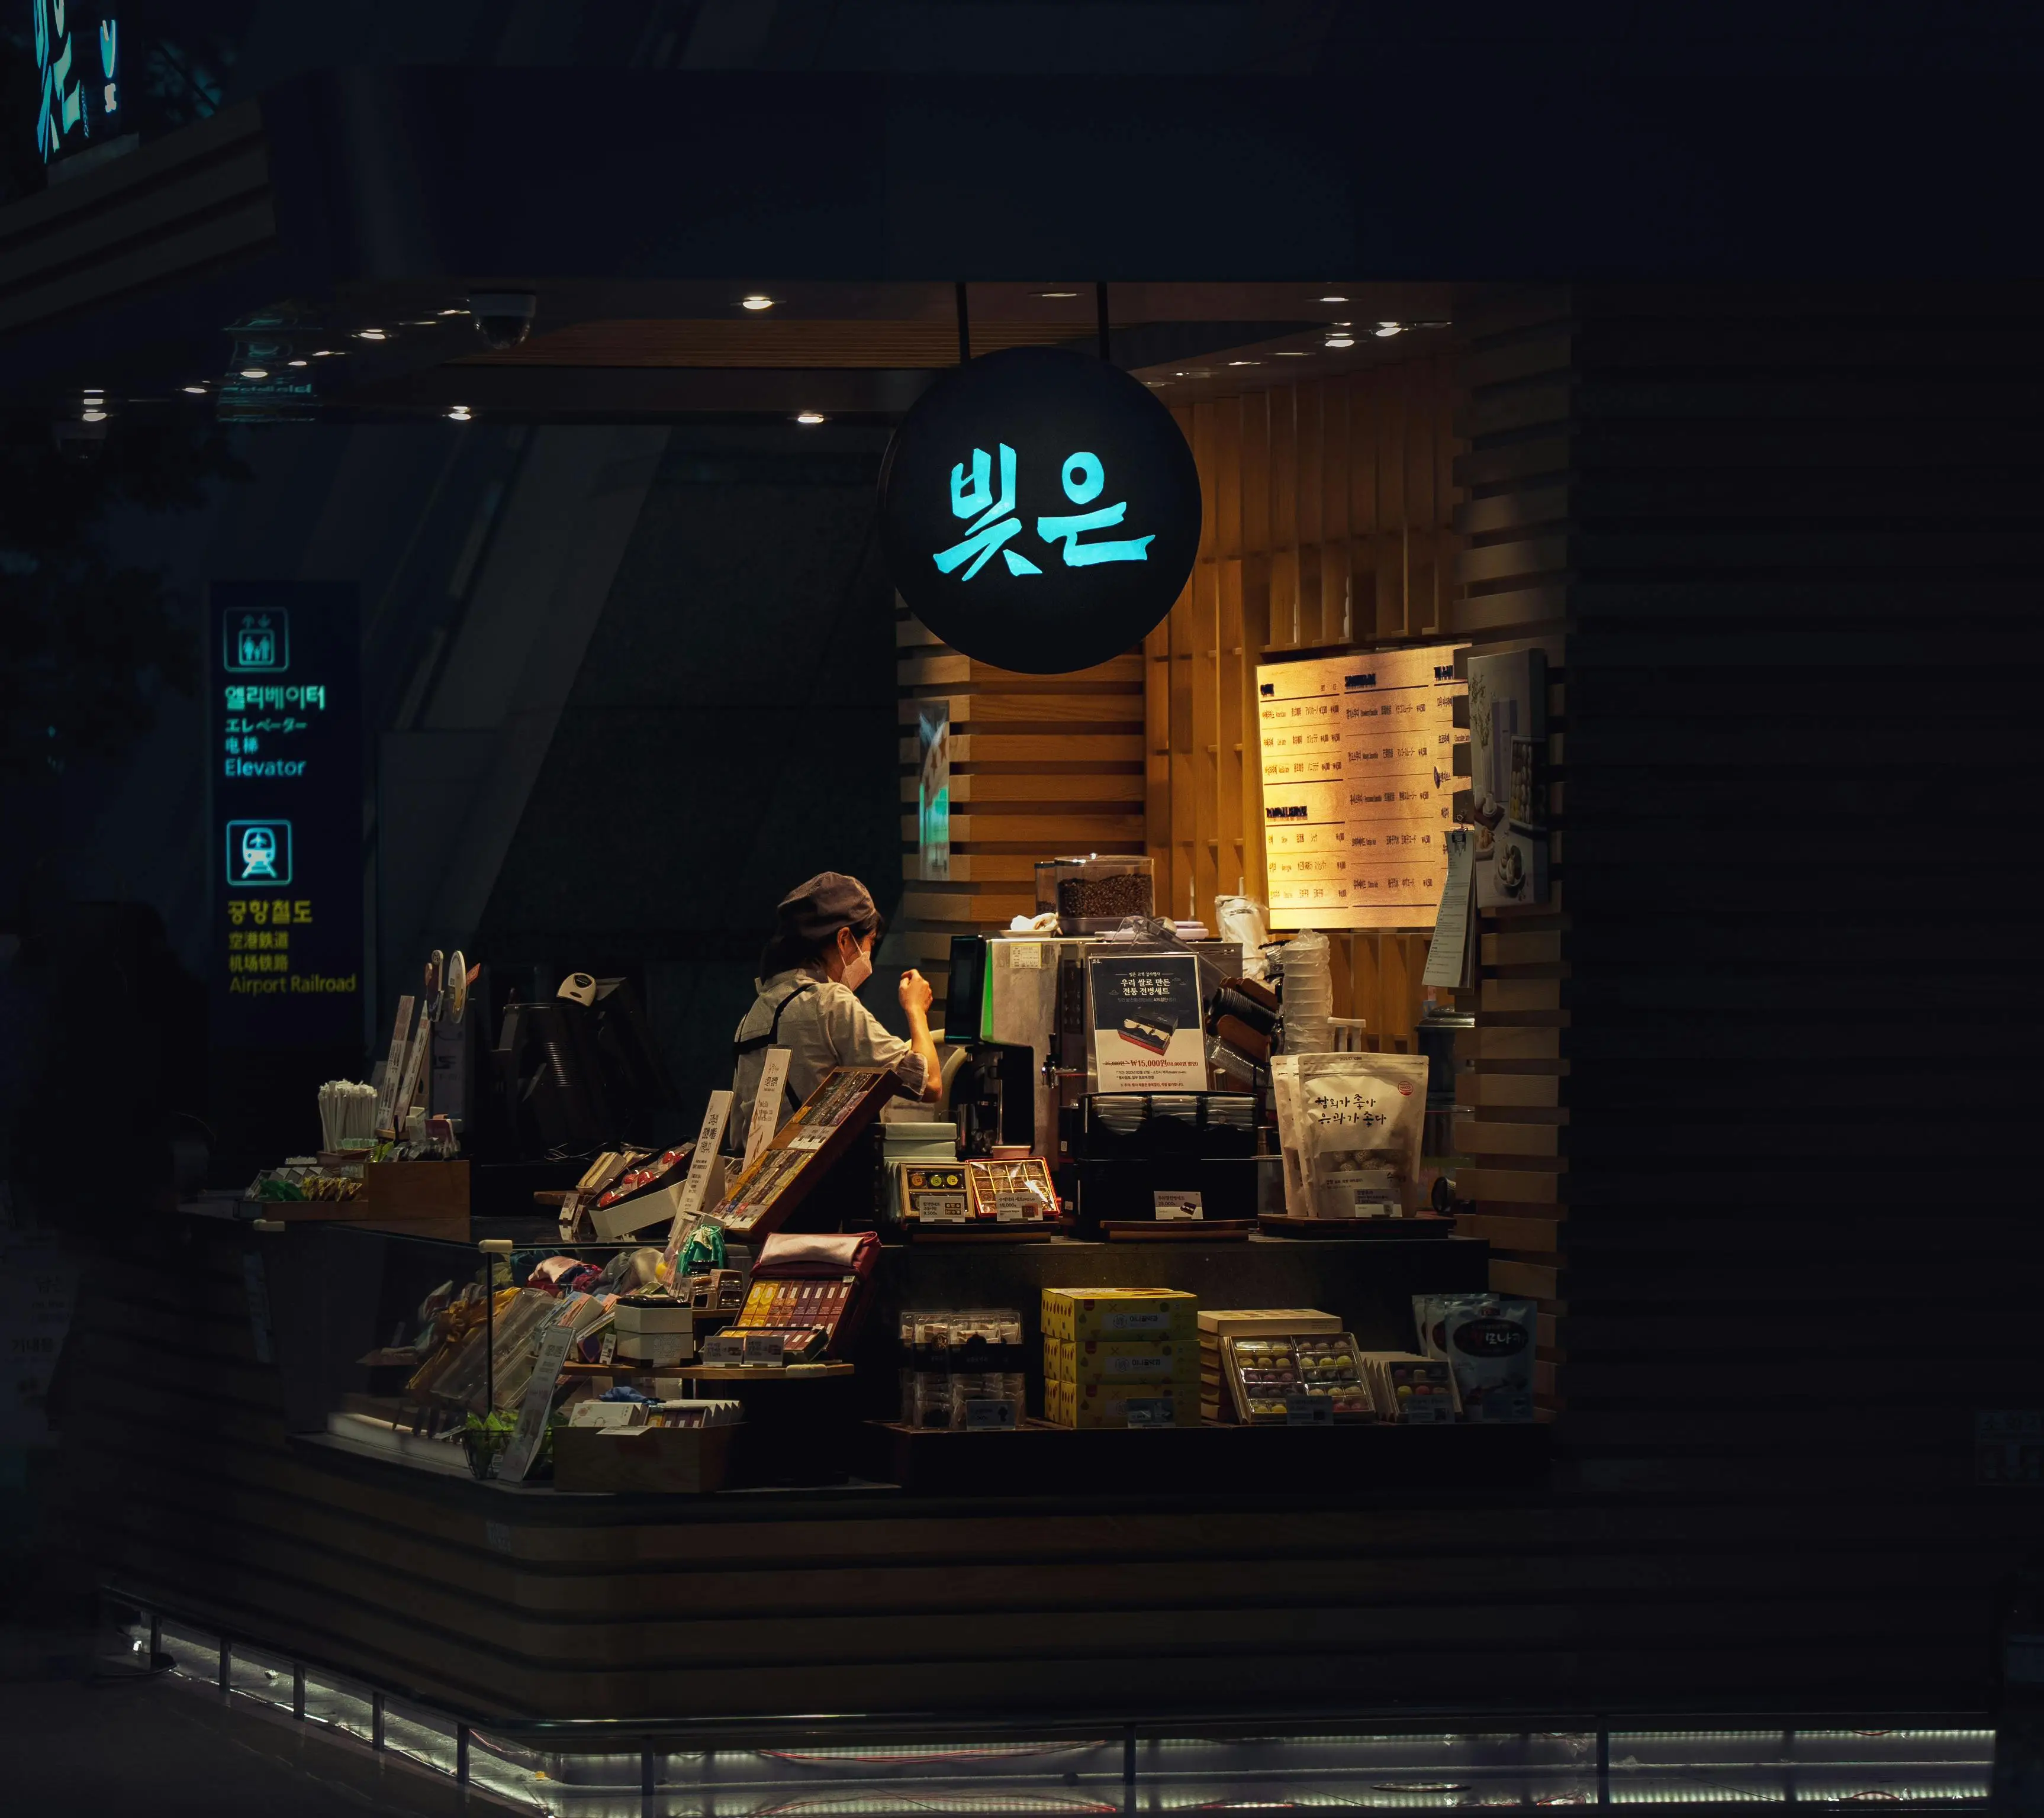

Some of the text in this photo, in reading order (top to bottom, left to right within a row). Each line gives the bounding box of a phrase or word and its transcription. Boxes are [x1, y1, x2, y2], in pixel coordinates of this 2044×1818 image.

[933, 443, 1155, 581] 빚은
[225, 685, 325, 710] 엘리베이터
[226, 717, 307, 733] エレベーター
[226, 757, 307, 776] Elevator
[228, 900, 313, 924] 공항철도
[228, 954, 288, 973] 机场铁路
[230, 973, 356, 997] Airport Railroad
[1121, 978, 1171, 987] 우리 쌀로 만든
[1123, 987, 1170, 996] 전통 전병세트
[1353, 1094, 1376, 1110] 좋아
[1318, 1111, 1387, 1127] 유과가 좋다
